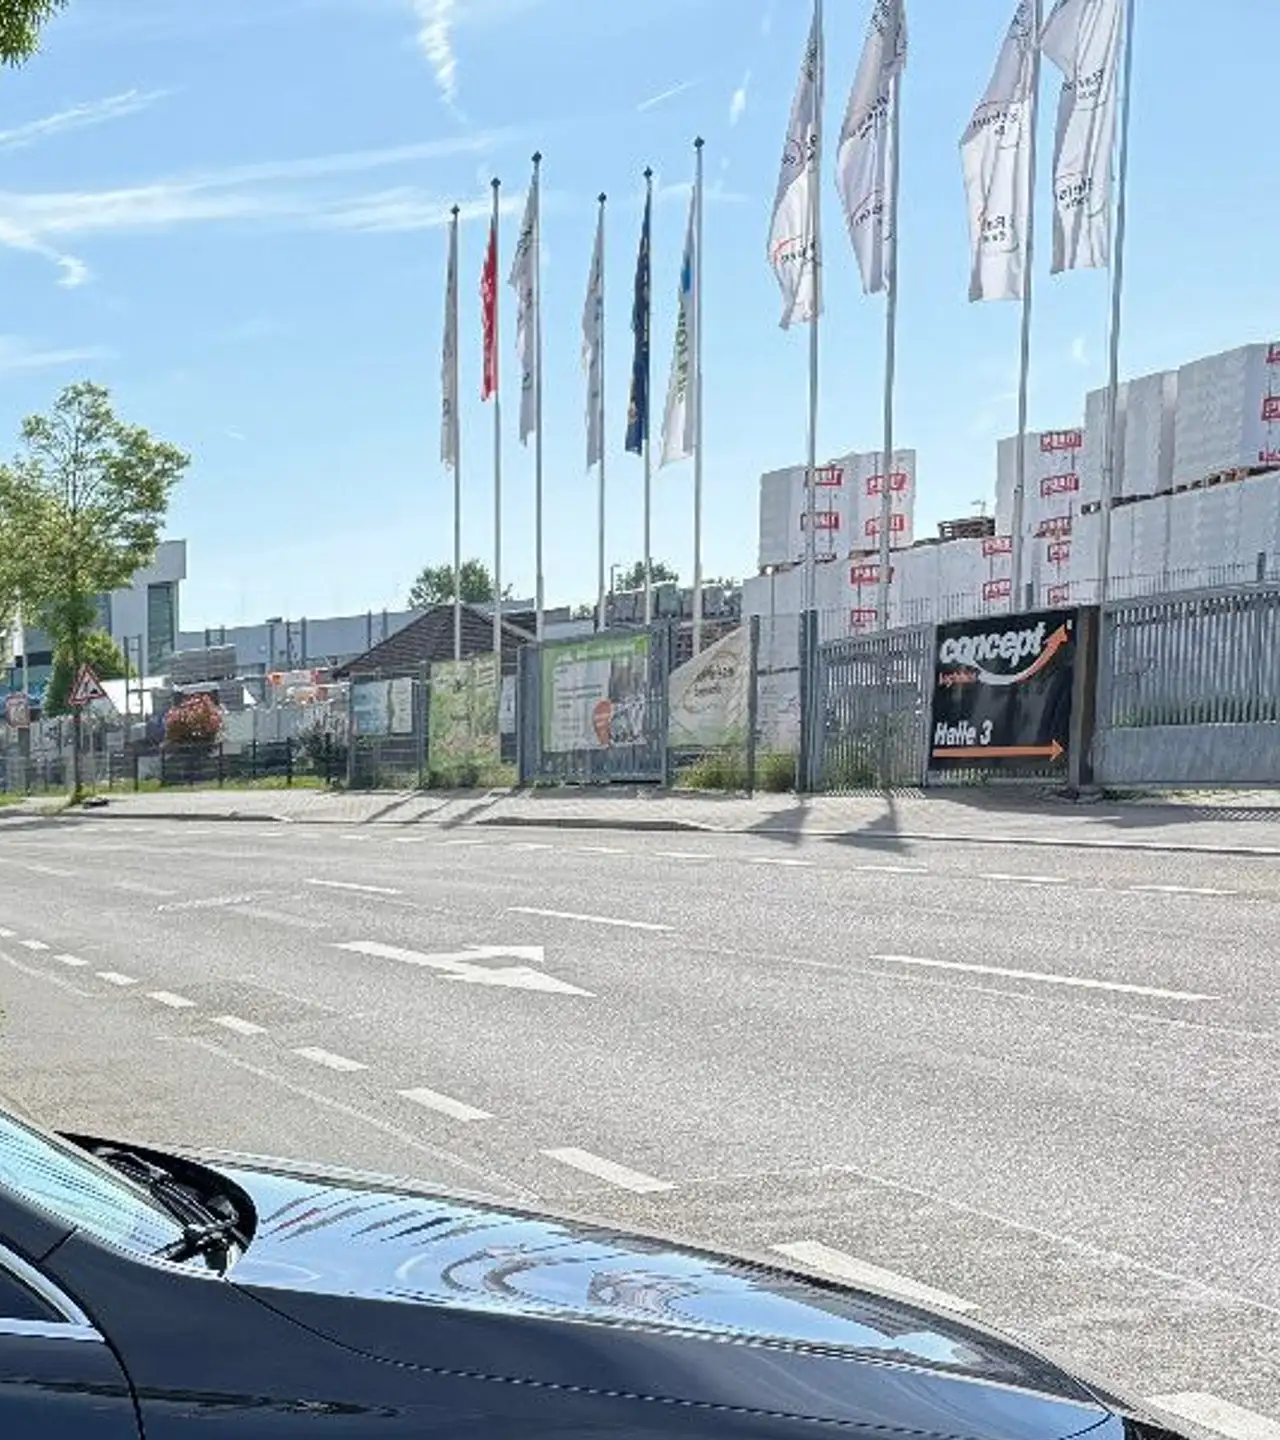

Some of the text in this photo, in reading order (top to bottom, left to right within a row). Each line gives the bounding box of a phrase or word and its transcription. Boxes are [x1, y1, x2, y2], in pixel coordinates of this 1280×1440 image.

[939, 621, 1046, 667] concept
[934, 719, 993, 746] Halle 3
